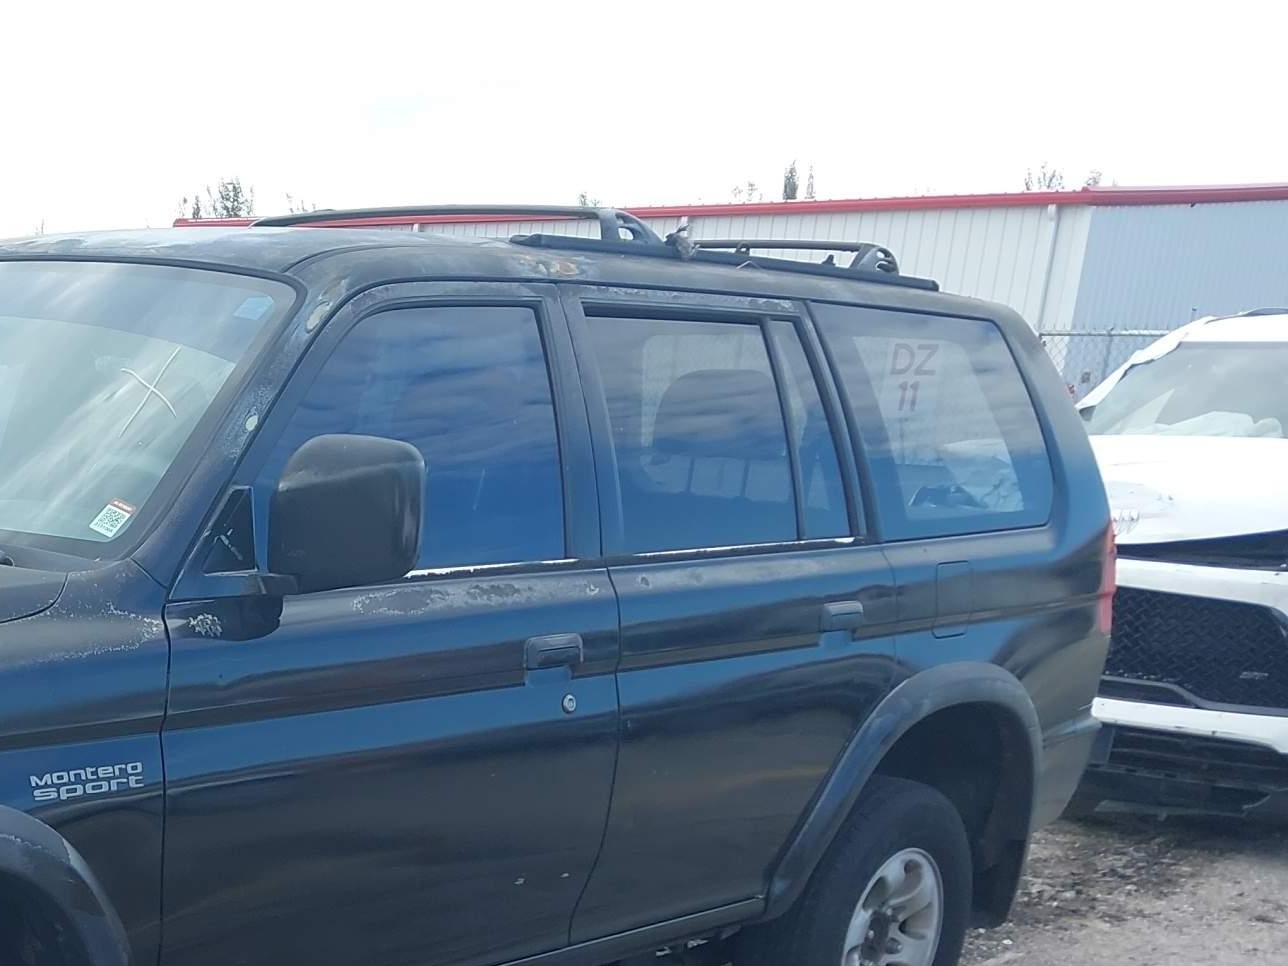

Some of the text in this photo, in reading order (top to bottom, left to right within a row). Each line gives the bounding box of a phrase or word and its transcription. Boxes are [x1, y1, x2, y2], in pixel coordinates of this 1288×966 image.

[889, 343, 939, 376] DZ
[897, 380, 920, 411] 11
[29, 761, 143, 787] Montero
